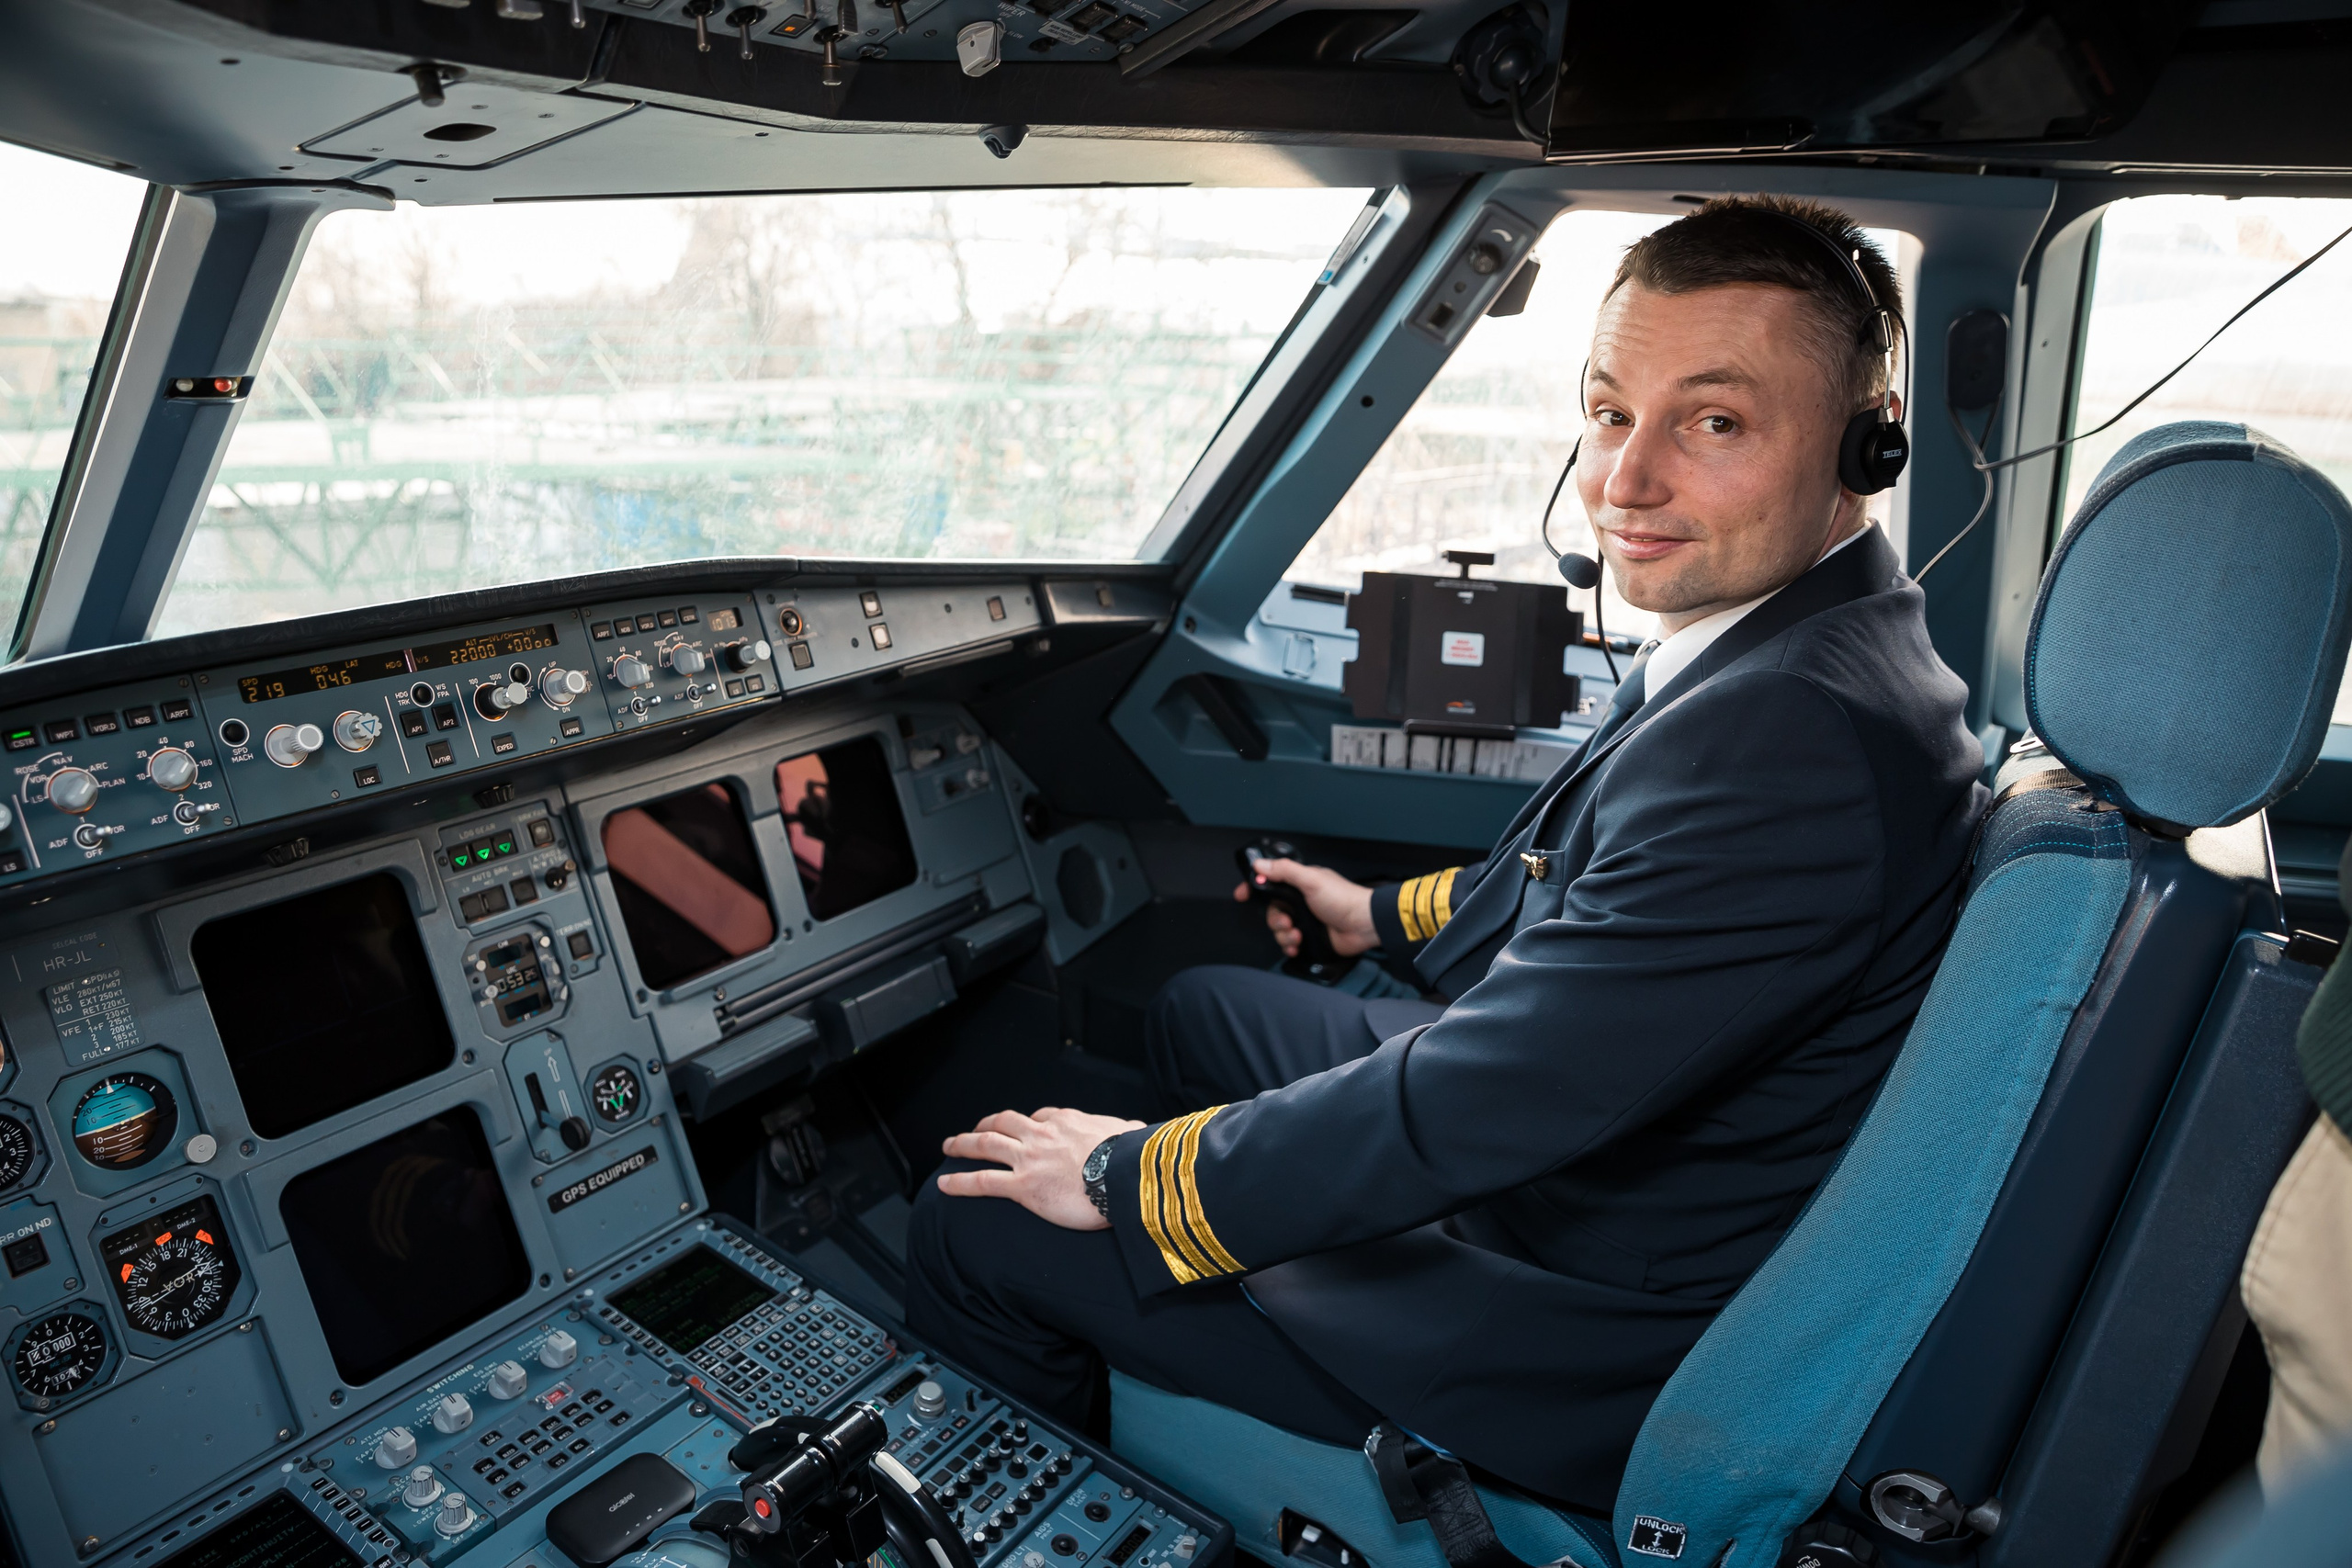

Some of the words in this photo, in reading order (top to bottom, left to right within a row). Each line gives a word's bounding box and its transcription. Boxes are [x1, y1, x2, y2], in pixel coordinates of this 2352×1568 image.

[998, 2, 1026, 17] WIPER
[1060, 28, 1083, 39] REPELLENT
[1883, 448, 1902, 459] TELEX
[488, 633, 514, 643] LVL/CH
[596, 630, 610, 638] ARPT
[450, 644, 496, 664] 22000
[310, 665, 329, 675] HDG
[345, 660, 358, 669] LAT
[385, 660, 402, 670] HDG
[415, 656, 429, 664] V/S
[242, 678, 258, 687] SPD
[316, 671, 351, 689] 046
[489, 673, 502, 682] 1000
[395, 691, 408, 699] HDG
[398, 698, 411, 706] TRK
[170, 709, 189, 719] ARPT
[134, 716, 151, 725] NDB
[443, 718, 455, 727] AP2
[94, 723, 116, 733] VOR.D
[412, 725, 423, 733] AP1
[566, 727, 580, 736] APPR
[56, 730, 74, 739] WPT
[13, 738, 35, 749] CSTR
[158, 737, 169, 745] 40
[185, 740, 195, 749] 80
[232, 747, 248, 755] SPD
[497, 742, 514, 752] EXPED
[136, 750, 148, 759] 20
[232, 753, 254, 763] MACH
[434, 755, 452, 765] A/THR
[52, 755, 74, 766] NAV
[199, 759, 213, 767] 160
[15, 764, 40, 776] ROSE
[89, 762, 109, 772] ARC
[29, 774, 47, 784] VOR
[102, 778, 126, 788] PLAN
[363, 776, 376, 785] LOC
[198, 781, 212, 790] 320
[31, 795, 44, 804] LS
[151, 815, 169, 826] ADF
[184, 824, 201, 835] OFF
[475, 823, 496, 835] GEAR
[49, 838, 69, 850] ADF
[85, 848, 104, 859] OFF
[4, 863, 17, 873] LS
[471, 871, 492, 883] AUTO
[52, 938, 76, 950] SELCAL
[79, 931, 98, 942] CODE
[43, 950, 92, 972] HR-JL
[52, 982, 75, 995] LIMIT
[51, 995, 70, 1006] VLE
[54, 1004, 73, 1015] VLO
[79, 996, 98, 1008] EXT
[99, 989, 123, 1001] 250KT
[82, 1004, 101, 1016] RET
[102, 998, 127, 1010] 220KT
[105, 1008, 130, 1021] 230KT
[62, 1026, 82, 1037] VFE
[88, 1022, 104, 1033] 1+F
[108, 1015, 132, 1027] 215KT
[111, 1022, 135, 1035] 200KT
[112, 1030, 138, 1042] 185KT
[82, 1049, 105, 1061] FULL
[115, 1038, 140, 1050] 177KT
[81, 1108, 93, 1117] 20
[86, 1117, 97, 1126] 10
[93, 1136, 104, 1145] 10
[93, 1146, 106, 1155] 20
[561, 1182, 588, 1203] GPS
[588, 1153, 645, 1190] EQUIPPED
[17, 1224, 34, 1237] ON
[35, 1217, 51, 1230] ND
[176, 1217, 196, 1230] DME-2
[119, 1243, 138, 1255] DME-1
[176, 1248, 187, 1258] 21
[160, 1250, 172, 1261] 18
[191, 1252, 204, 1264] 24
[144, 1260, 157, 1272] 15
[137, 1277, 149, 1288] 12
[202, 1280, 213, 1292] 30
[193, 1294, 207, 1308] 33
[52, 1337, 72, 1352] 000
[758, 1343, 767, 1351] A
[783, 1359, 791, 1368] K
[426, 1364, 475, 1393] SWITCHING
[469, 1381, 486, 1393] CAPT
[415, 1402, 428, 1412] AIR
[428, 1393, 446, 1405] DATA
[414, 1413, 432, 1426] CAPT
[360, 1434, 373, 1445] ATT
[374, 1427, 389, 1438] HDG
[524, 1435, 537, 1444] PRESS
[356, 1448, 374, 1461] CAPT
[502, 1448, 515, 1459] BLEED
[537, 1444, 549, 1454] DOOR
[481, 1463, 492, 1472] ENG
[515, 1459, 528, 1469] COND
[555, 1458, 566, 1466] STS
[494, 1474, 505, 1483] APU
[384, 1483, 406, 1499] UPPER
[511, 1487, 522, 1496] CLR
[1066, 1487, 1085, 1506] DFDR
[608, 1492, 636, 1513] alcatel
[1073, 1494, 1088, 1508] EVENT
[421, 1506, 433, 1515] OFF
[413, 1510, 435, 1528] LOWER
[1034, 1521, 1052, 1538] AIDS
[1639, 1517, 1683, 1535] UNLOCK
[452, 1534, 464, 1544] OFF
[1040, 1527, 1055, 1540] PRINT
[1017, 1545, 1026, 1556] LT
[1642, 1544, 1670, 1555] LOCK
[192, 1549, 218, 1567] TIME
